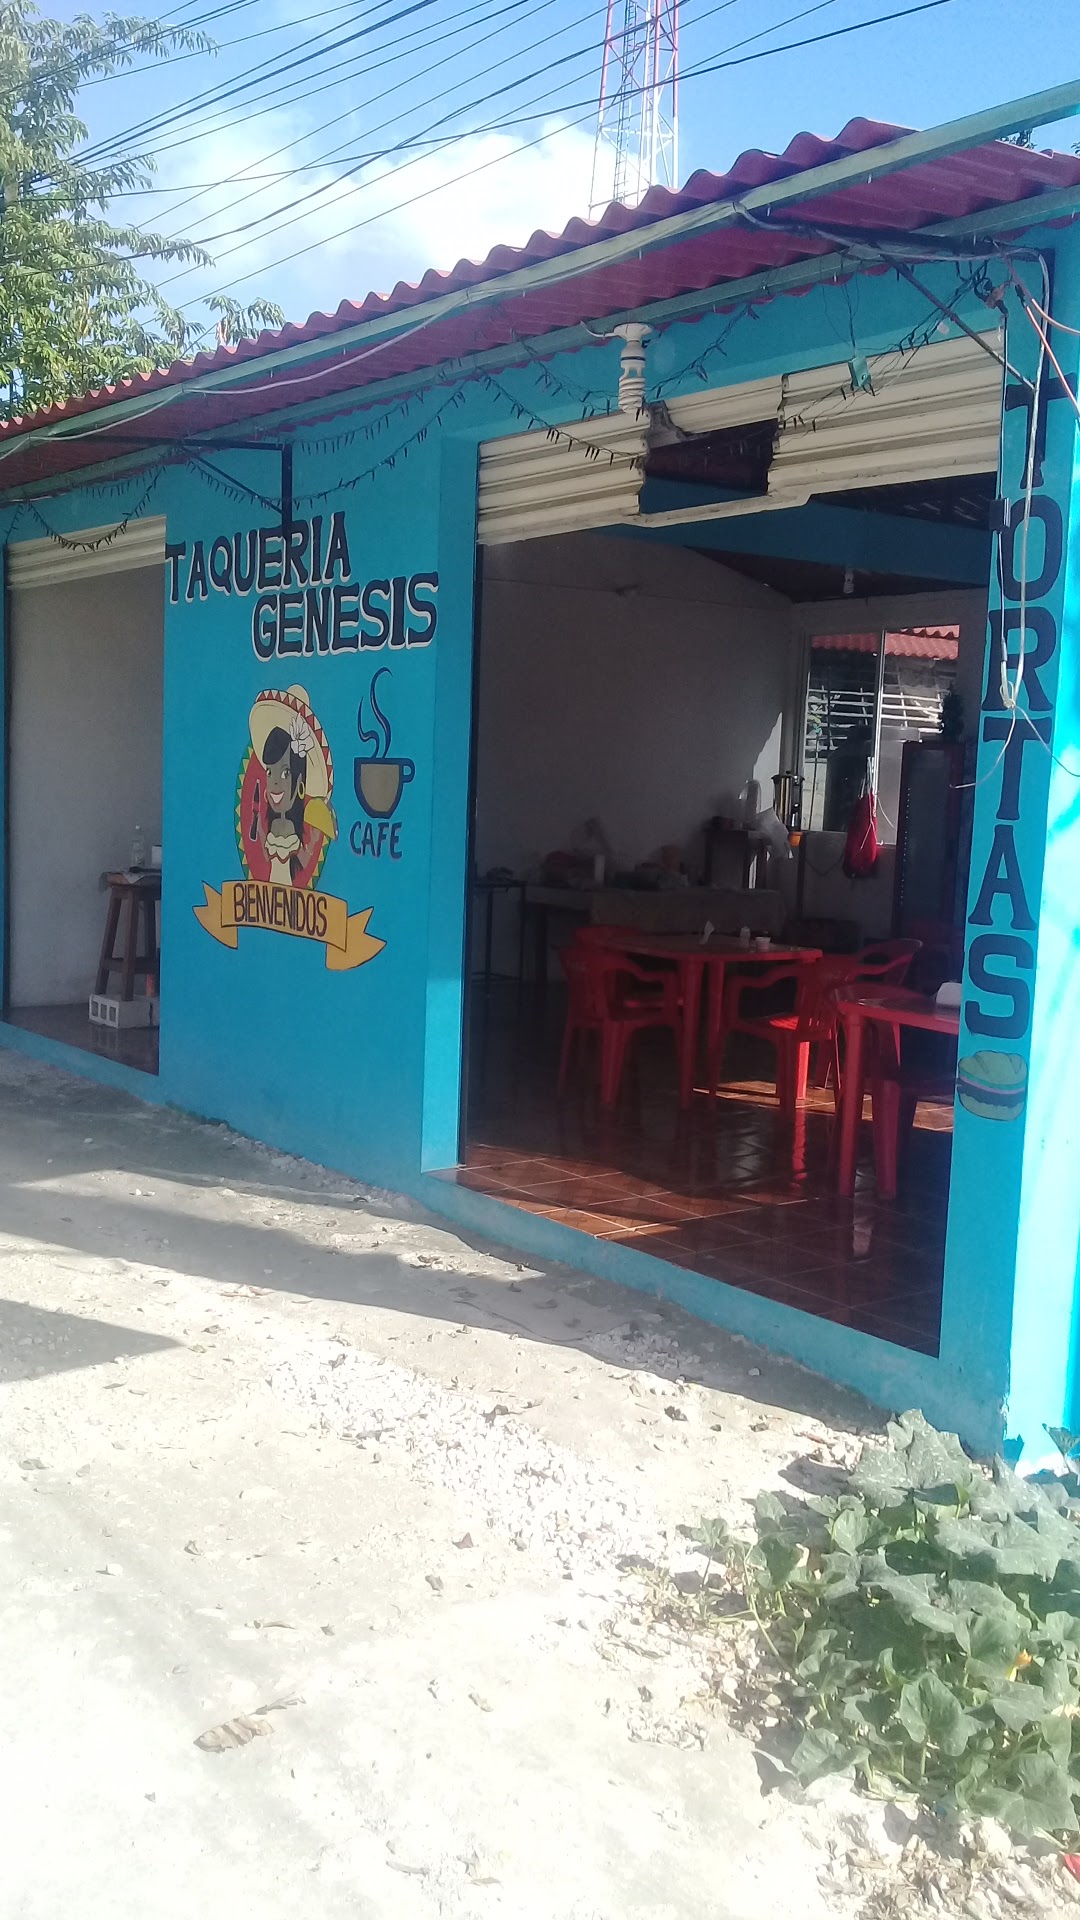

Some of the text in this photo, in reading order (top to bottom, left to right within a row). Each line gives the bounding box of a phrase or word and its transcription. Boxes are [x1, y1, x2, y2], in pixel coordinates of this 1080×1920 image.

[165, 511, 351, 604] TAQUERIA
[252, 571, 439, 662] GENESIS
[964, 372, 1077, 1040] TORTAS
[350, 821, 402, 861] CAFE
[233, 883, 328, 937] BIENVENIDOS
